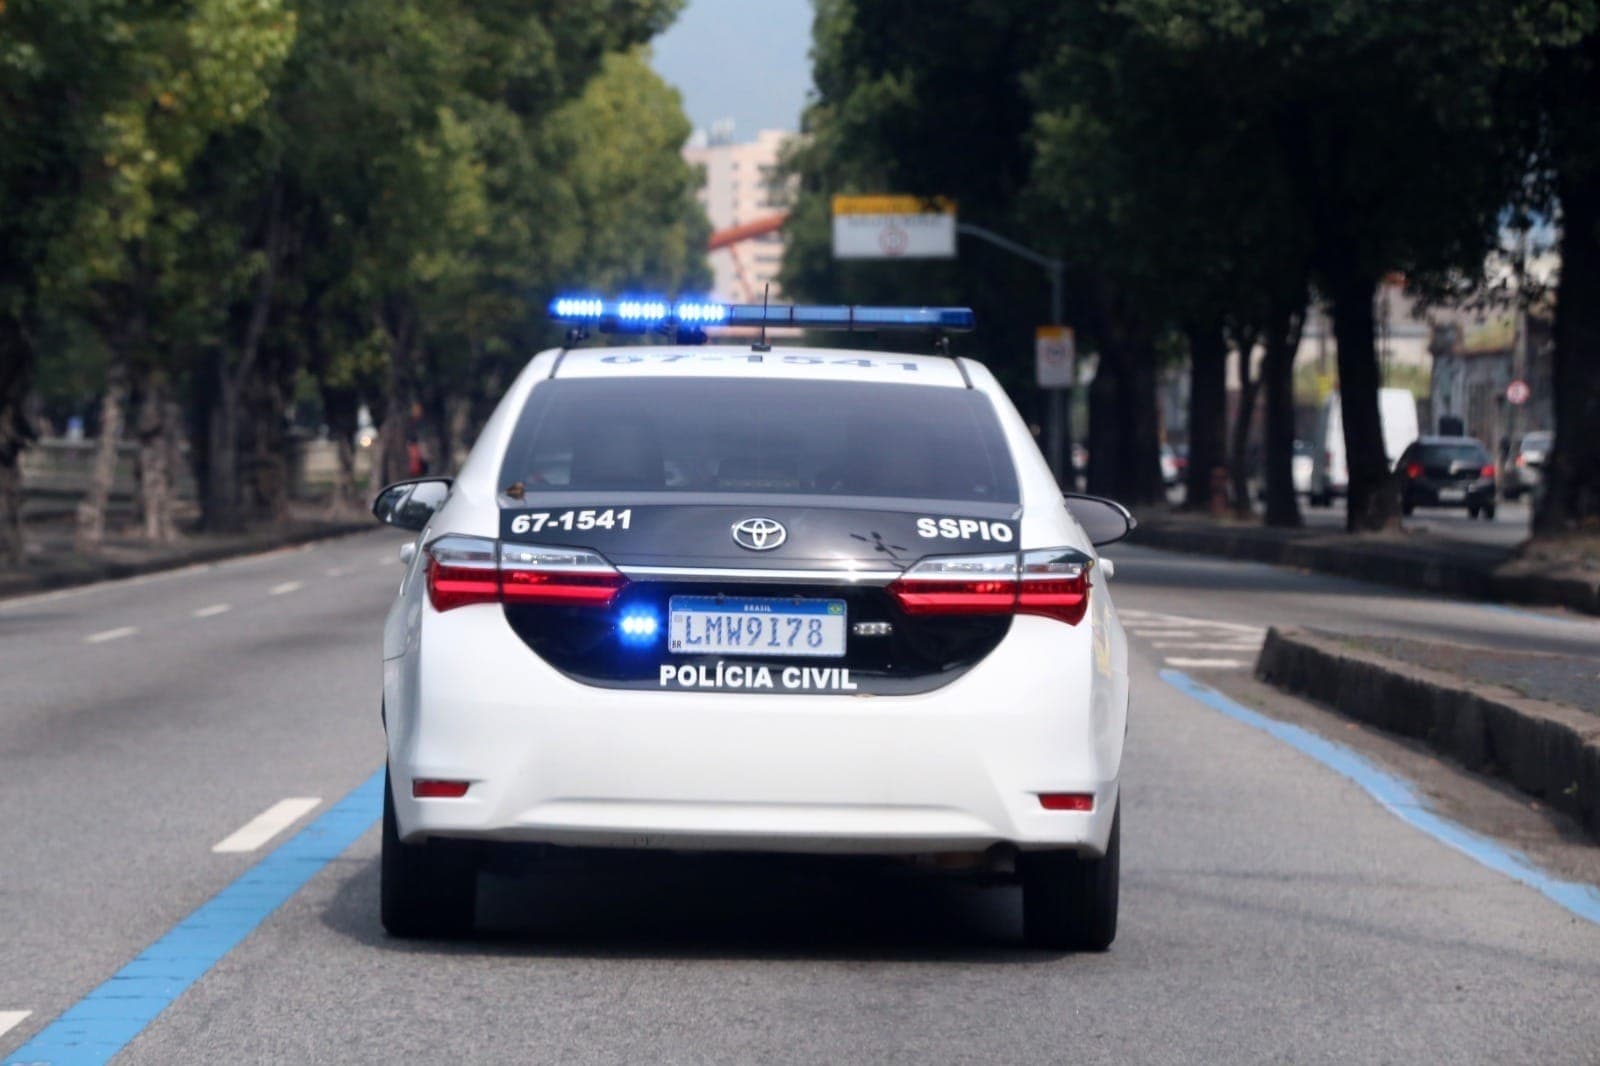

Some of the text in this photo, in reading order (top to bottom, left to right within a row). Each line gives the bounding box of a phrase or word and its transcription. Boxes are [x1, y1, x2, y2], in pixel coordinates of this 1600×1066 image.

[511, 509, 631, 534] 67-1541
[743, 604, 772, 613] BRASIL
[685, 615, 824, 648] LMW9I78
[659, 660, 858, 690] POLÍCIA CIVIL
